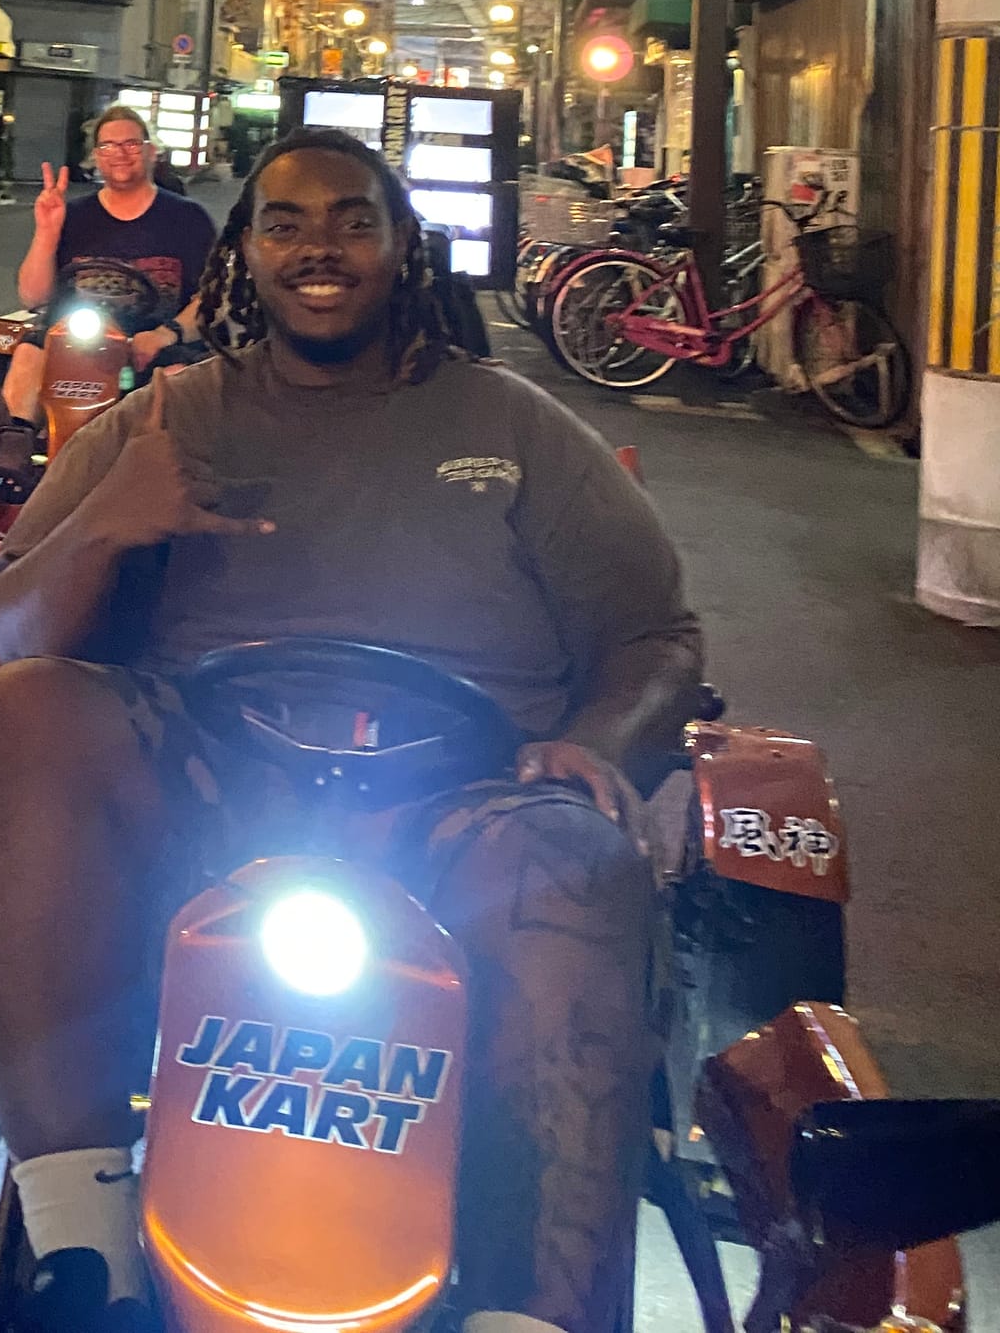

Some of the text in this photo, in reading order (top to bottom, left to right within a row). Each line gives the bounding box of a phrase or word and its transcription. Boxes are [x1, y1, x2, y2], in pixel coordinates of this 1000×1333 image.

[720, 807, 840, 875] 風神
[176, 1014, 453, 1104] JAPAN
[191, 1069, 428, 1155] KART
